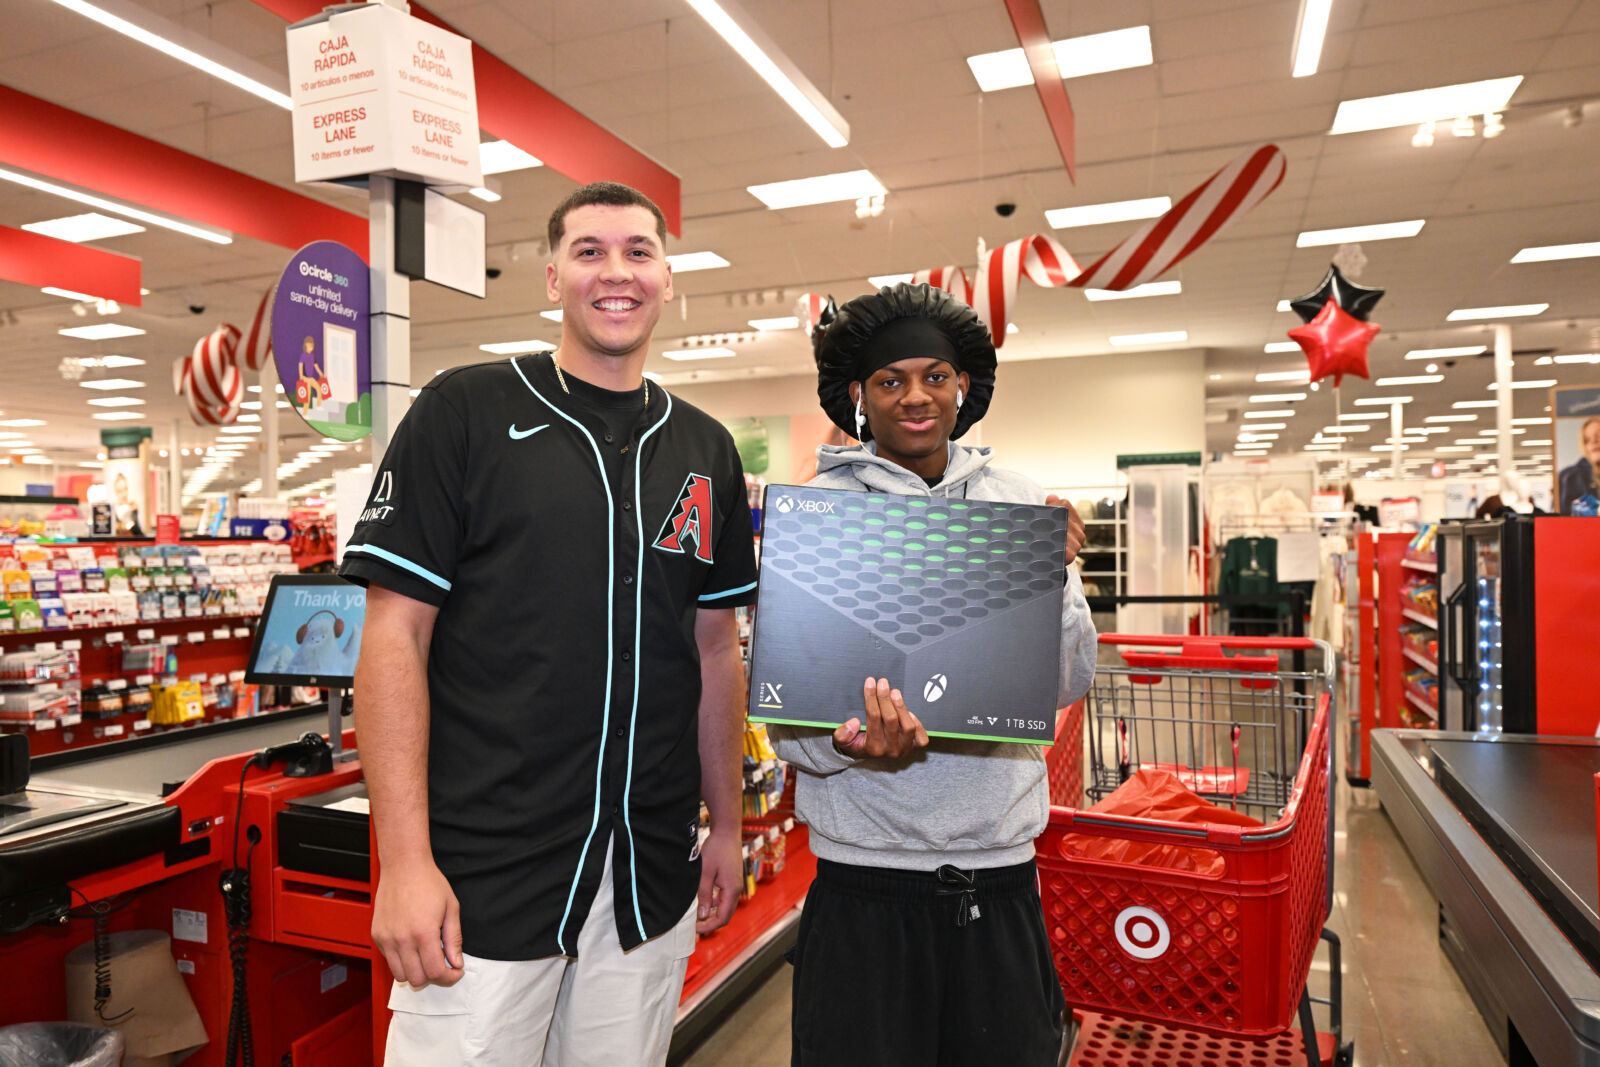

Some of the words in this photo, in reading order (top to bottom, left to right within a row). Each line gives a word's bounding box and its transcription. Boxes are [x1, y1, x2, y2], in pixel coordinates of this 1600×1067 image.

[319, 35, 349, 54] CAJA
[417, 40, 447, 62] CAJA
[314, 51, 357, 72] RÁPIDA
[413, 54, 454, 80] RÁPIDA
[301, 82, 309, 91] 10
[342, 75, 347, 83] o
[349, 69, 375, 80] menos
[398, 69, 408, 80] 10
[313, 106, 367, 129] EXPRESS
[412, 109, 462, 135] EXPRESS
[325, 126, 357, 143] LANE
[424, 129, 454, 148] LANE
[311, 151, 320, 161] 10
[321, 150, 341, 160] items
[343, 148, 351, 156] or
[352, 144, 375, 154] fewer
[411, 145, 420, 155] 10
[421, 147, 441, 160] items
[442, 153, 449, 162] or
[450, 153, 469, 166] fewer
[309, 264, 333, 282] circle
[333, 273, 349, 287] 360
[308, 284, 342, 303] unlimited
[290, 291, 329, 312] same-day
[329, 302, 358, 321] delivery
[796, 499, 836, 514] XBOX
[294, 590, 341, 607] Thank
[1006, 719, 1010, 727] 1
[1012, 719, 1025, 729] TB
[1027, 719, 1046, 730] SSD
